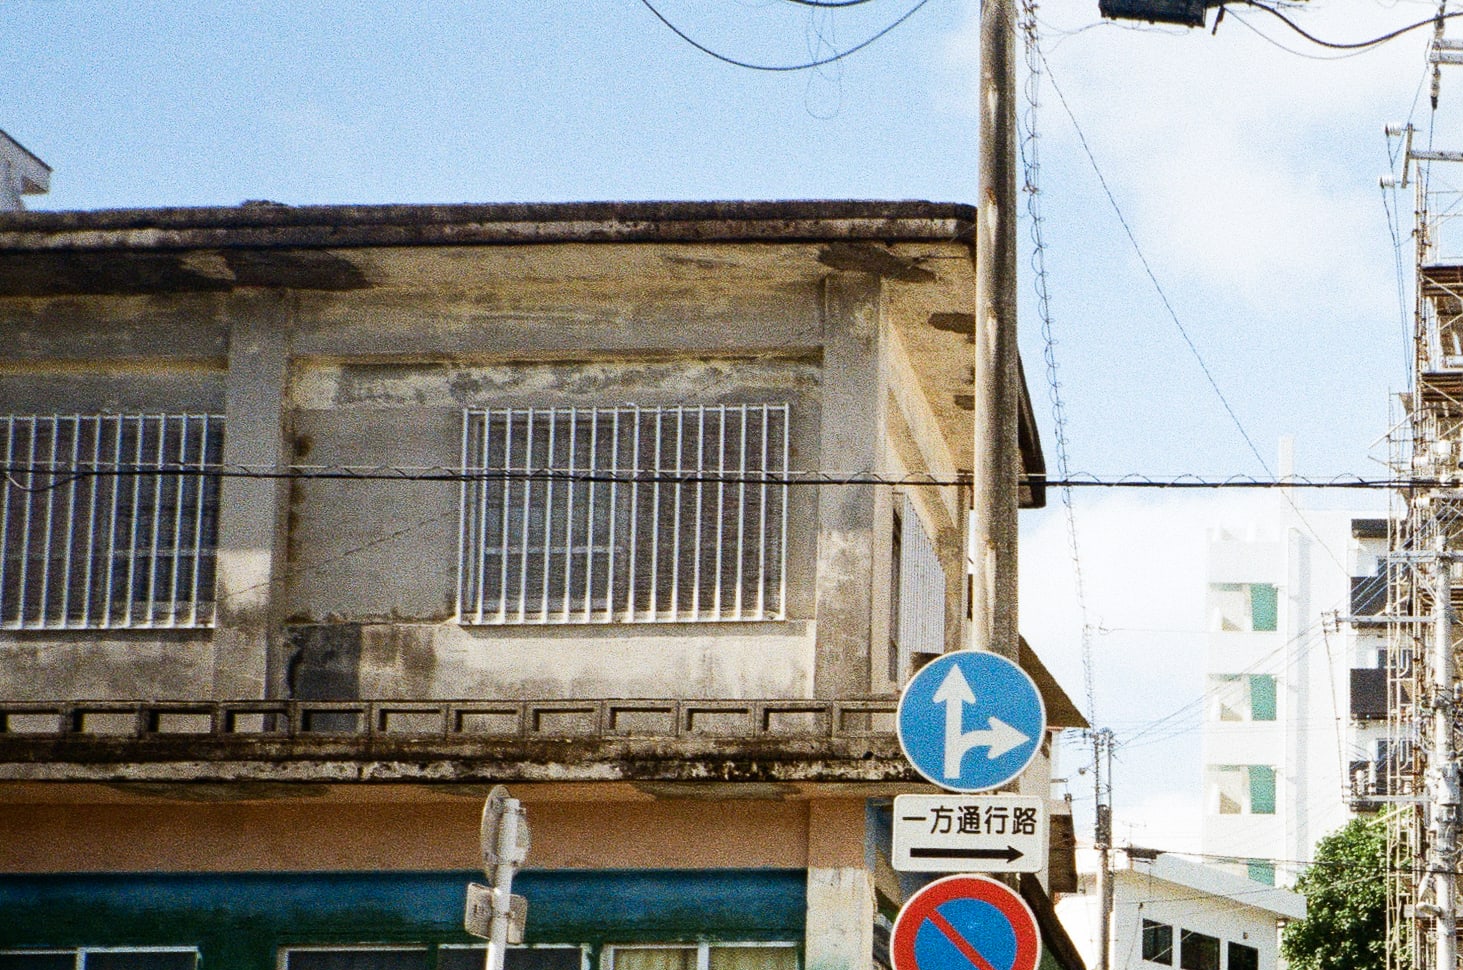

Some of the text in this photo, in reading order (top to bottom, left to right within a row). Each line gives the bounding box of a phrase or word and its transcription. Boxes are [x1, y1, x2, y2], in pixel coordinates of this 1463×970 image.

[902, 806, 1039, 836] 一方通行路
